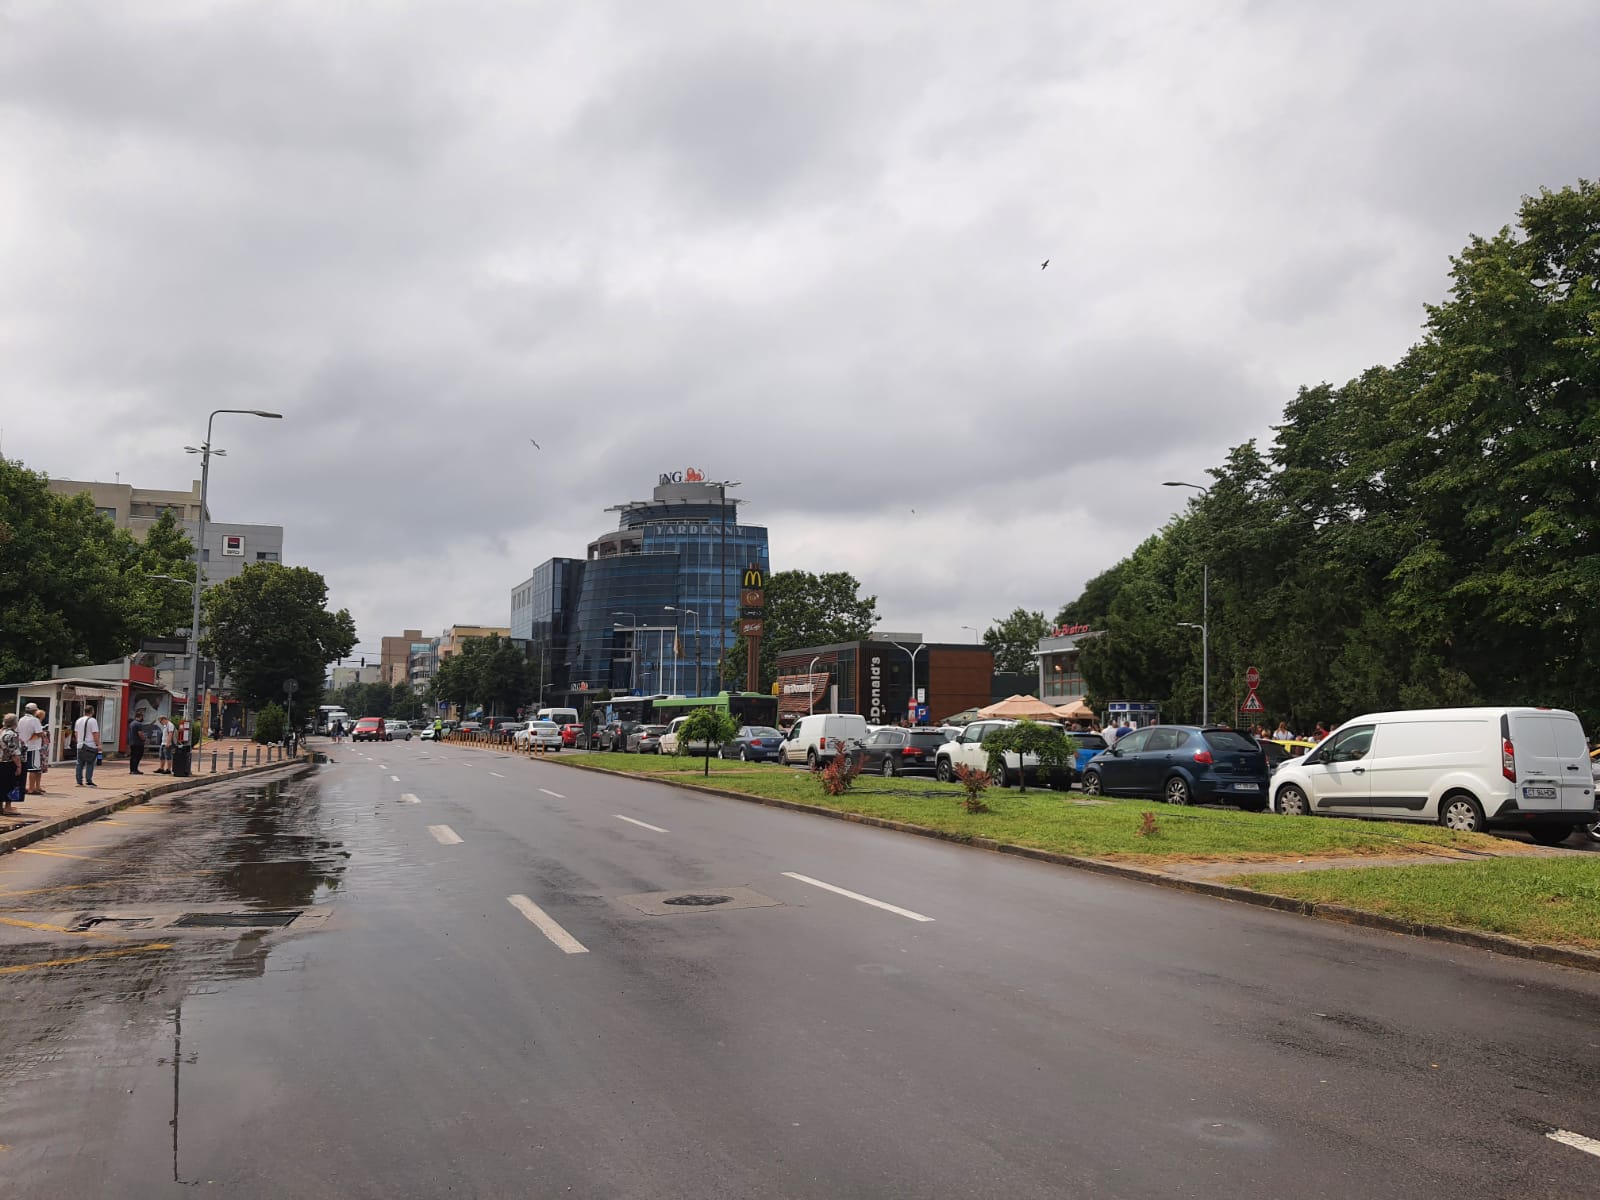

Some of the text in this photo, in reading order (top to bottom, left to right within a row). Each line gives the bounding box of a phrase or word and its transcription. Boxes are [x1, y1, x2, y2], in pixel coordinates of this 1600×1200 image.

[659, 471, 682, 485] ING
[656, 524, 744, 536] YARDENNY
[1246, 673, 1259, 682] STOP
[870, 656, 881, 724] cDonald's
